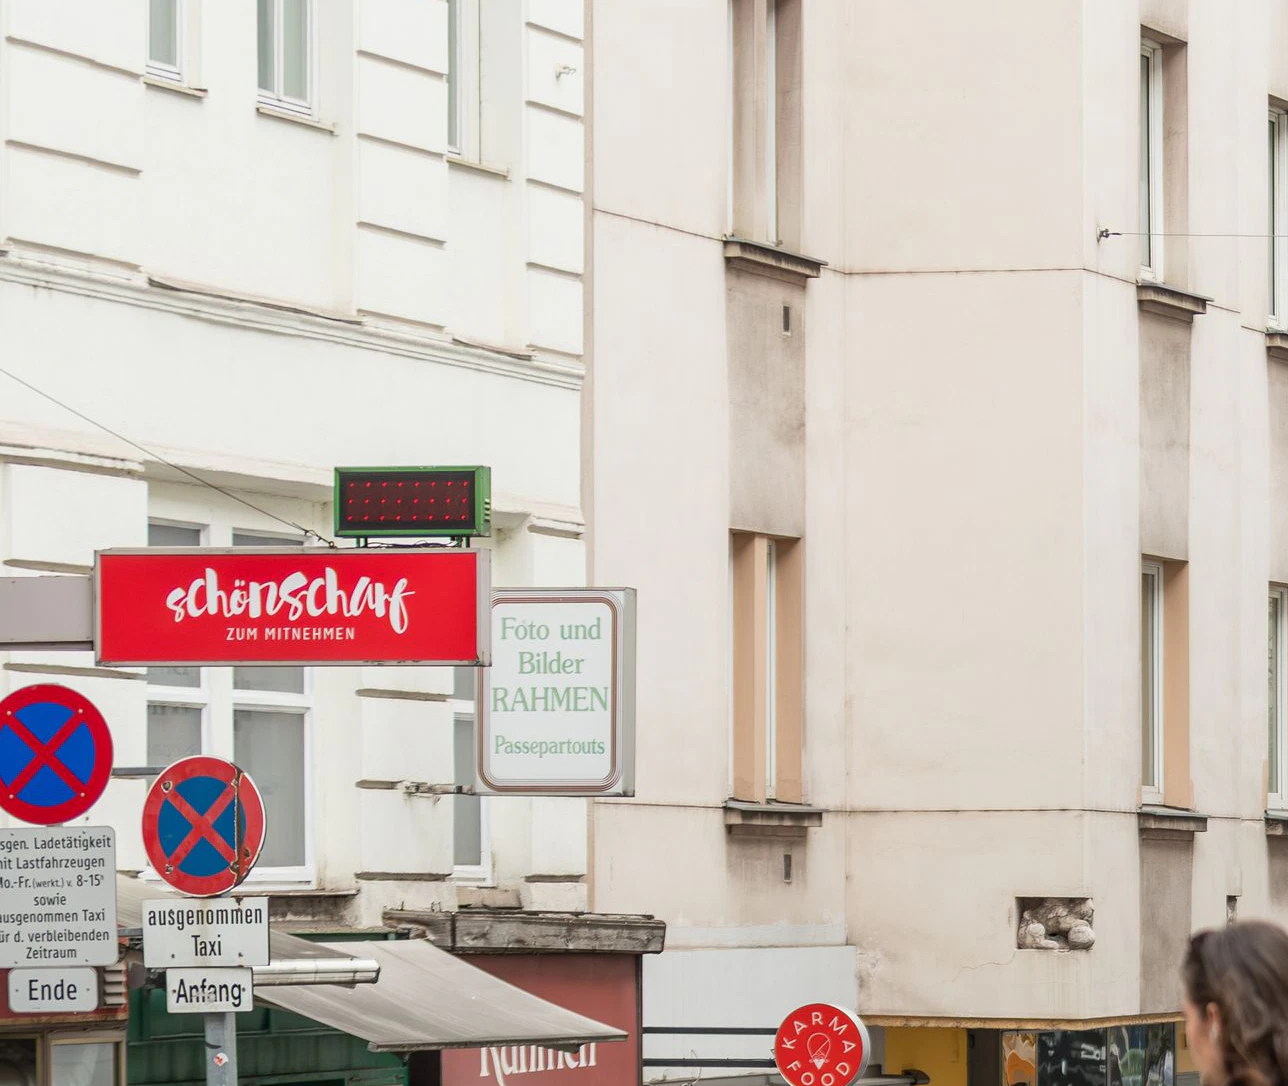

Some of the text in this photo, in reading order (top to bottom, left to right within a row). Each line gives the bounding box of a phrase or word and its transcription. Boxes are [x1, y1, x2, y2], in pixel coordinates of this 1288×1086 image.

[166, 567, 416, 634] schönscharf
[226, 627, 356, 641] ZUM MITNEHMEN
[500, 617, 602, 642] Foto und
[517, 651, 584, 676] Bilder
[491, 686, 610, 713] RAHMEN
[494, 735, 605, 758] Passepartouts
[34, 835, 111, 851] Ladetätigkeit
[16, 856, 105, 870] Lastfahrzeugen
[33, 892, 67, 906] sowie
[82, 908, 105, 921] Taxi
[148, 908, 262, 932] ausgenommen
[14, 930, 24, 943] d.
[28, 929, 110, 942] verbleibenden
[191, 934, 222, 957] Taxi
[26, 946, 77, 959] Zeitraum
[28, 979, 77, 1001] Ende
[175, 978, 242, 1007] Anfang
[782, 1011, 856, 1054] KARMA
[786, 1060, 850, 1086] FOOD
